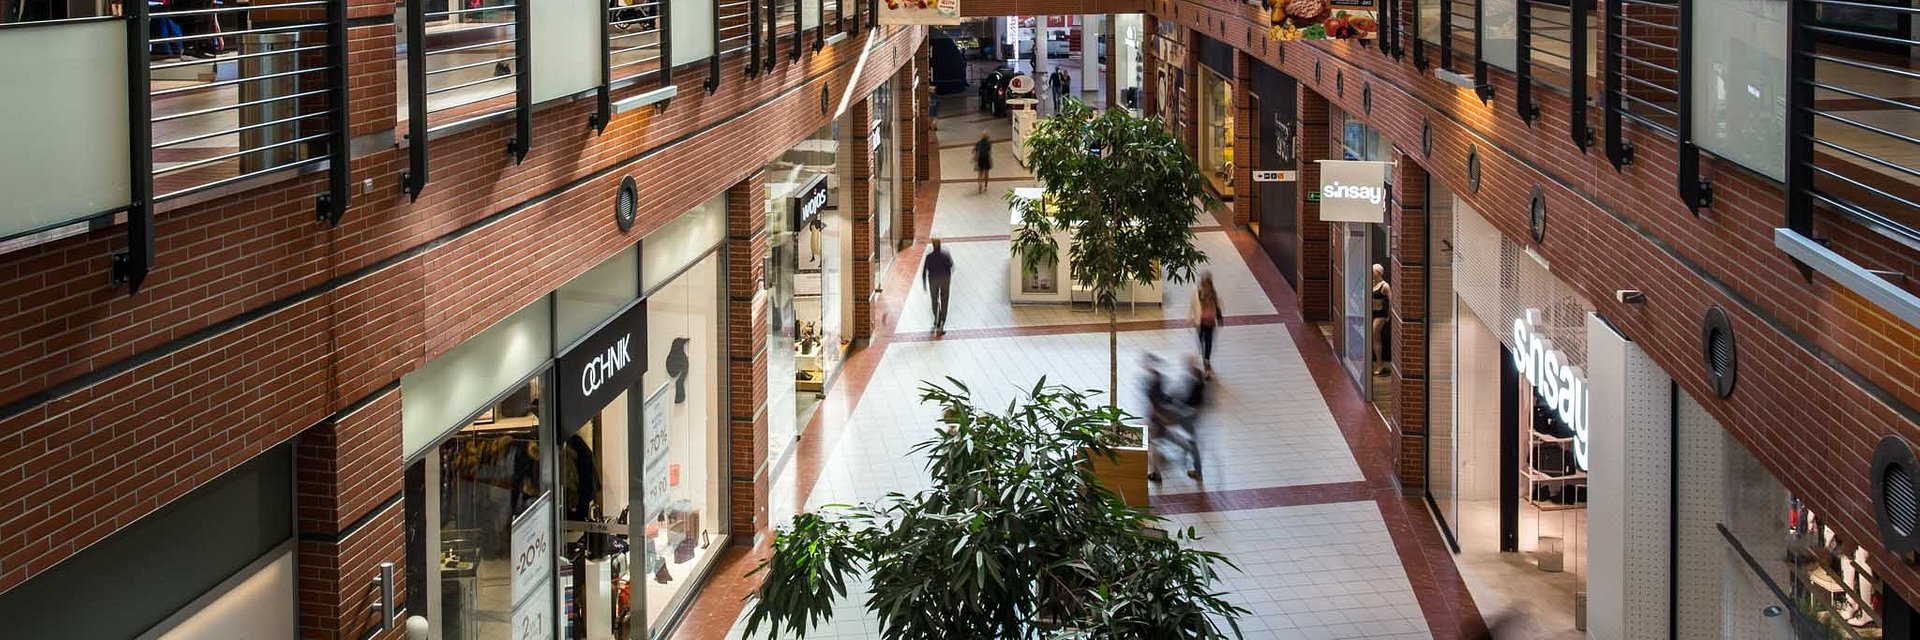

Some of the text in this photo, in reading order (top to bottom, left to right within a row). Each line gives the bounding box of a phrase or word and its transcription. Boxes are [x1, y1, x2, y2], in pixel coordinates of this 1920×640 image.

[1323, 181, 1381, 204] sinsay
[582, 333, 631, 396] OCHNIK
[1513, 308, 1588, 471] sinsay
[517, 533, 546, 574] -20%
